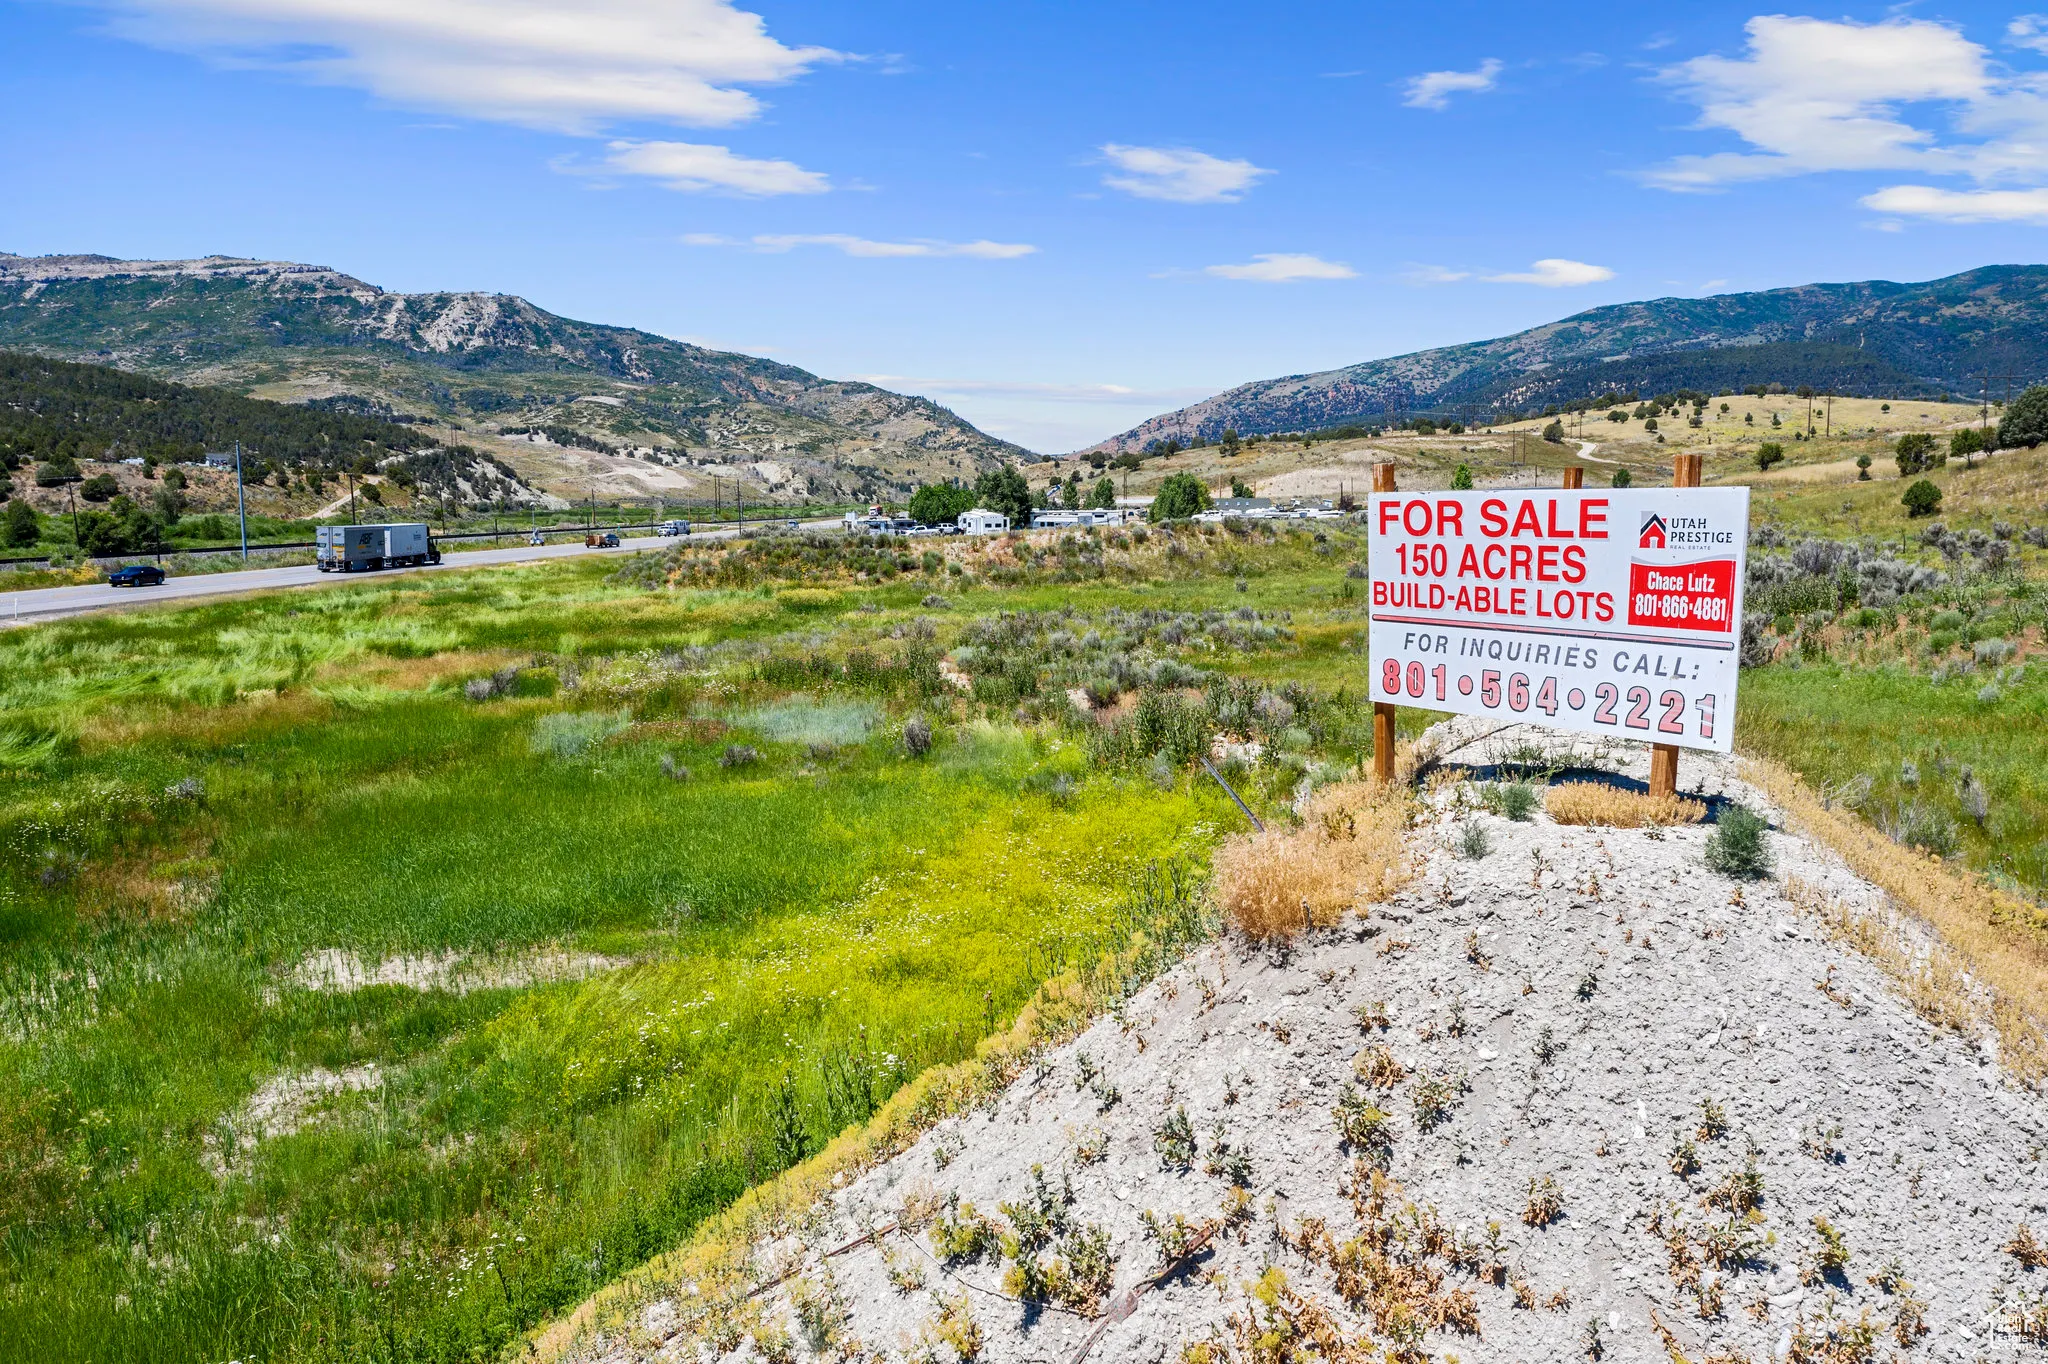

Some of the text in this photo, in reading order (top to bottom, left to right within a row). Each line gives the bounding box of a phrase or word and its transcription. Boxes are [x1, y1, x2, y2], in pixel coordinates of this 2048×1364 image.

[1379, 498, 1609, 539] FOR SALE
[1670, 531, 1733, 543] PRESTIGE
[1671, 518, 1707, 529] UTAH
[1395, 543, 1586, 583] 150 ACRES
[1647, 571, 1715, 592] Chace Lutz
[1373, 581, 1614, 622] BUILD-ABLE LOTS
[1403, 632, 1700, 680] FOR INQUIRIES CALL:
